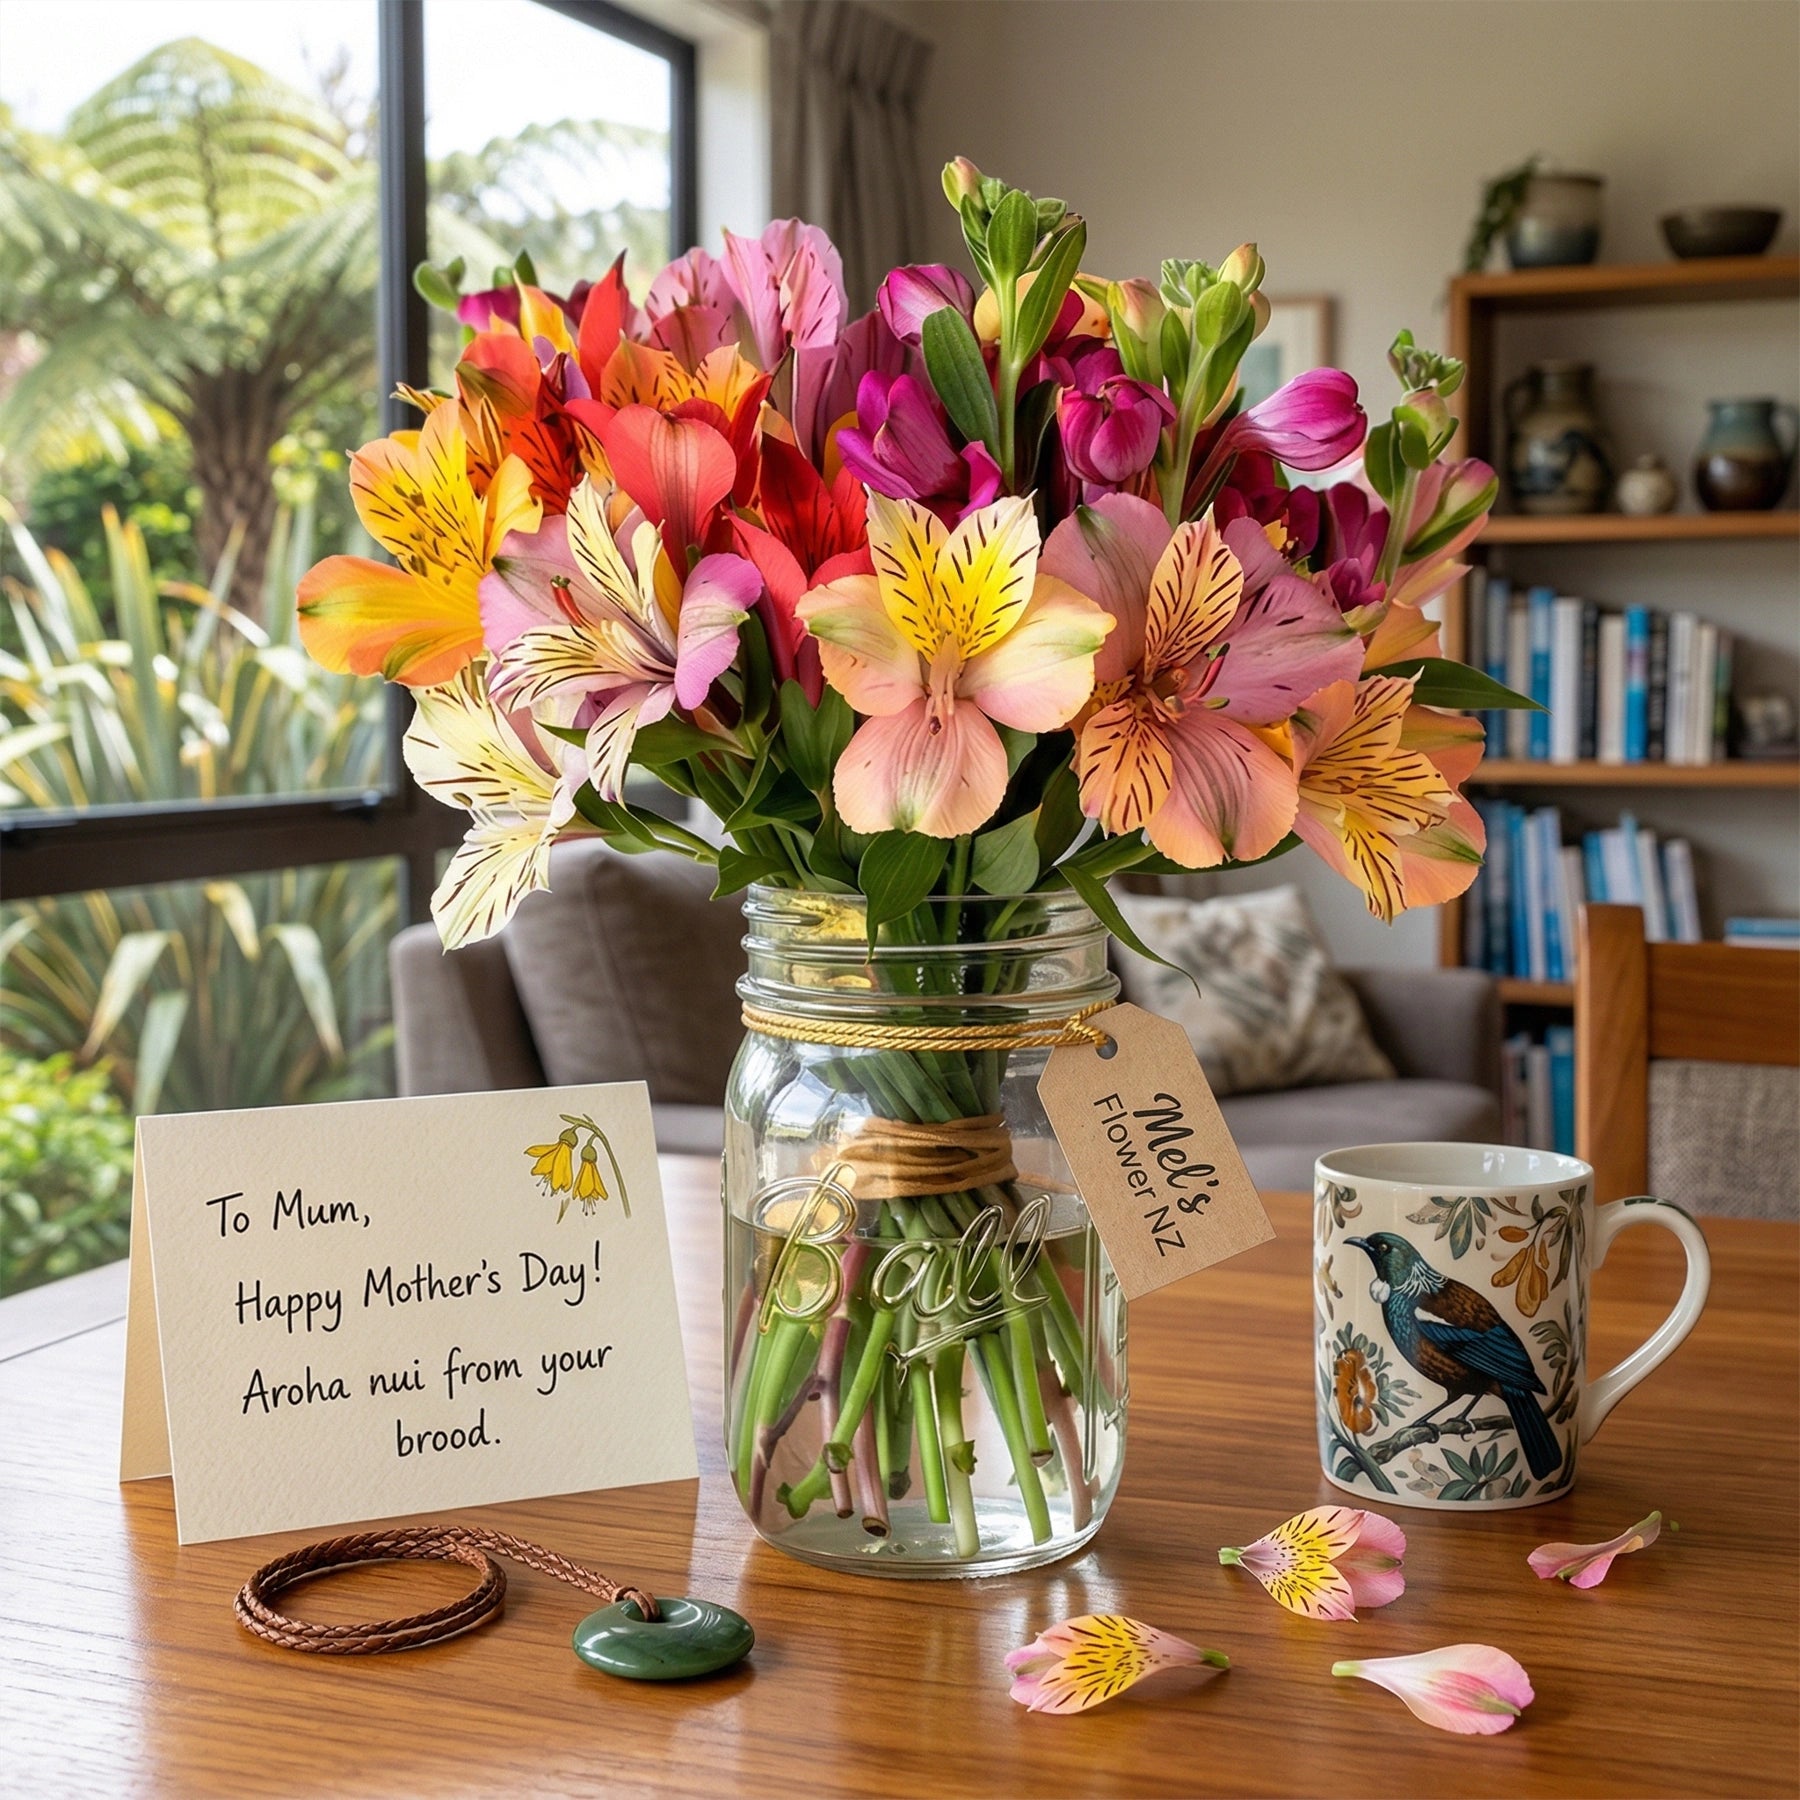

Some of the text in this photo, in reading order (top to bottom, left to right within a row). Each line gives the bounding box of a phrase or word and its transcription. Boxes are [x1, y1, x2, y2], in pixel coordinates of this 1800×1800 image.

[1093, 1092, 1187, 1258] Flower NZ
[1132, 1092, 1220, 1216] Mel's
[205, 1188, 371, 1238] To Mum,
[751, 1162, 1052, 1336] Ball
[234, 1239, 602, 1334] Happy Mother's Day!
[242, 1344, 613, 1415] Aroha nui from your
[396, 1407, 502, 1458] brood.
